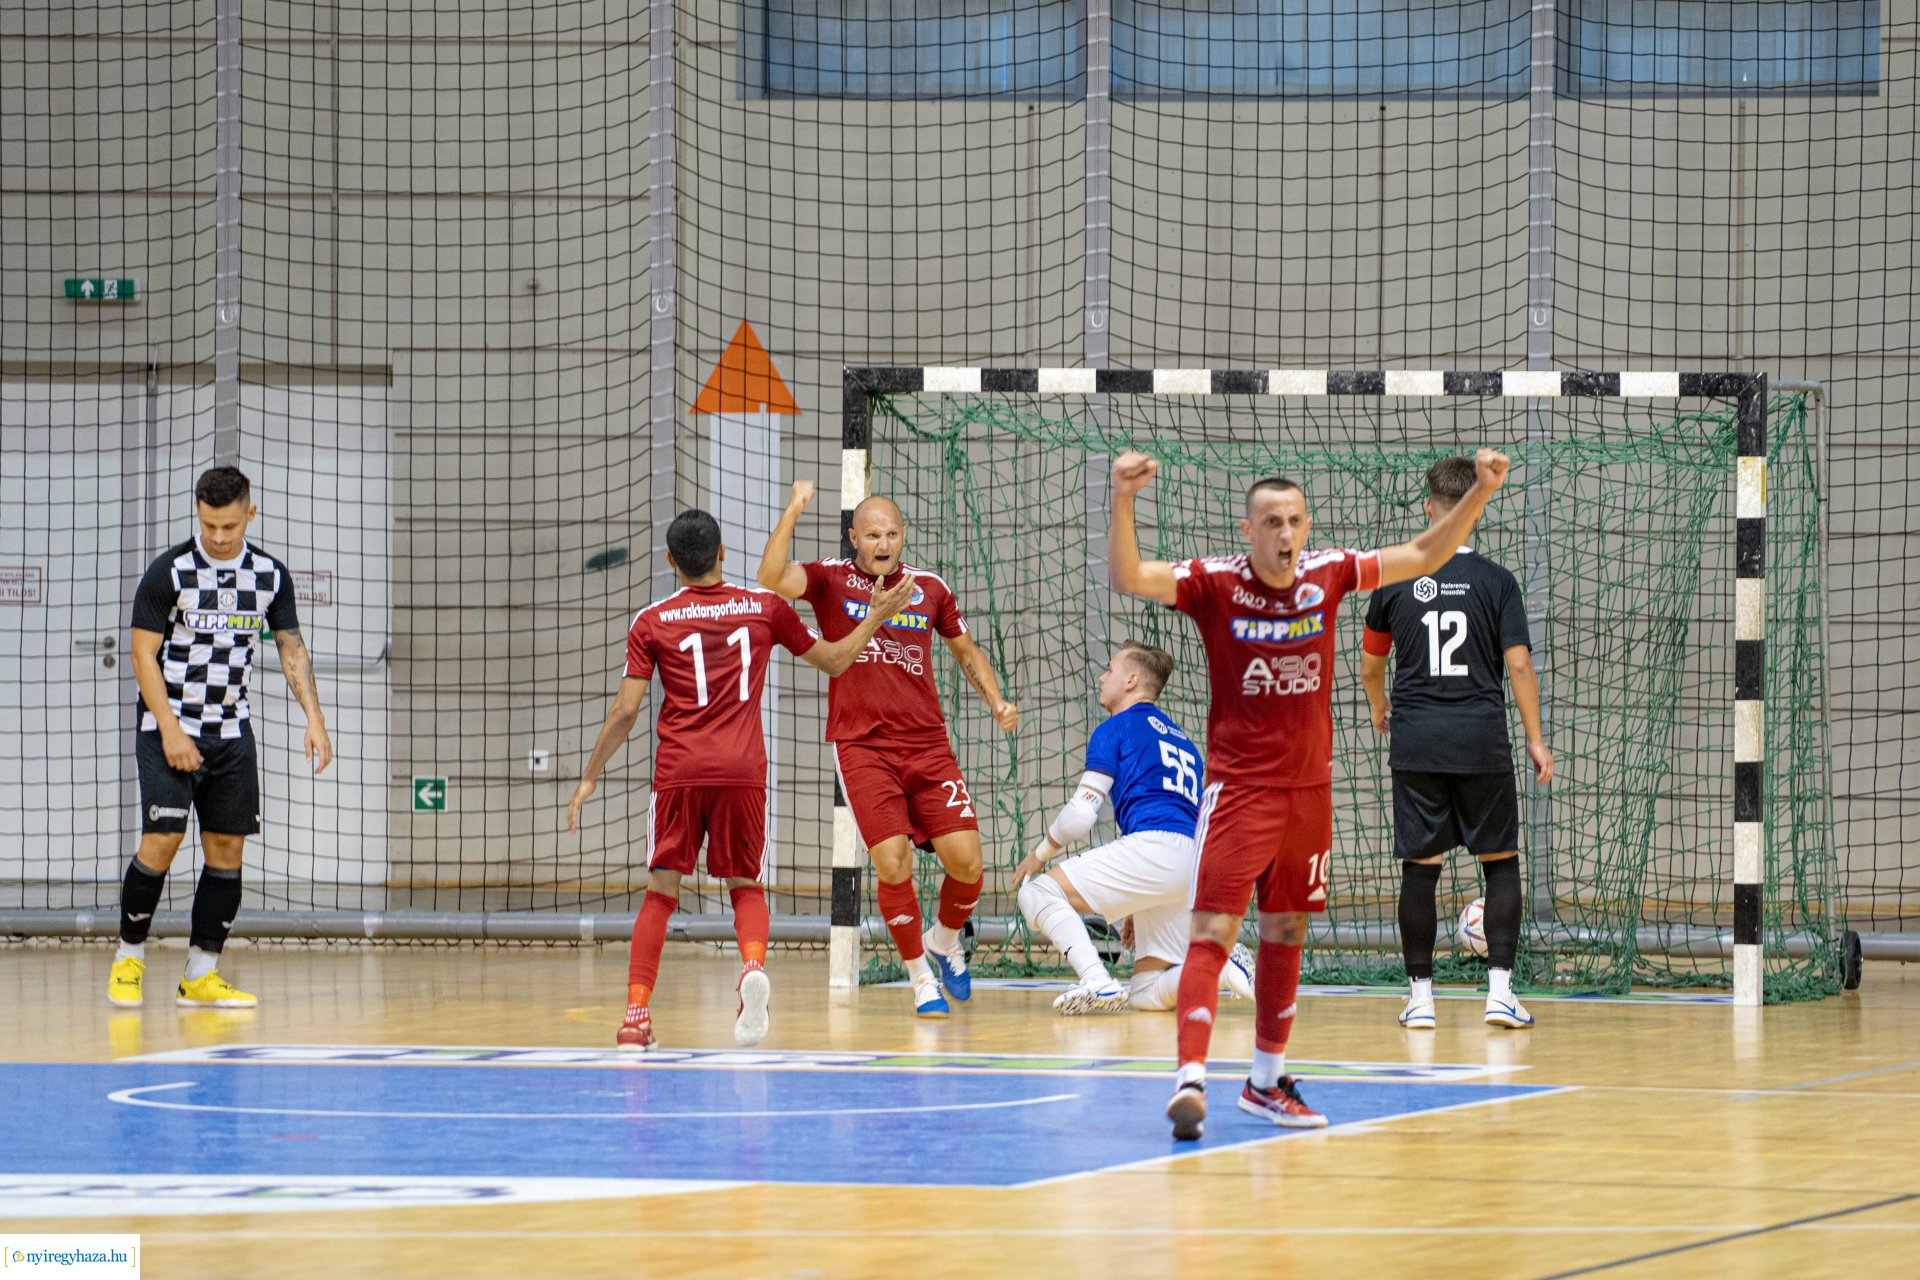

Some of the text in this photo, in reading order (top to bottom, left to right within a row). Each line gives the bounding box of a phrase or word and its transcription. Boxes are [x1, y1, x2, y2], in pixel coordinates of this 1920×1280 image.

[659, 597, 762, 622] www.raktarsportbolt.hu
[1421, 610, 1469, 677] 12
[678, 626, 752, 707] 11
[1241, 675, 1321, 696] STUDIO
[1158, 739, 1199, 807] 55
[941, 779, 972, 808] 23
[1308, 849, 1331, 886] 10
